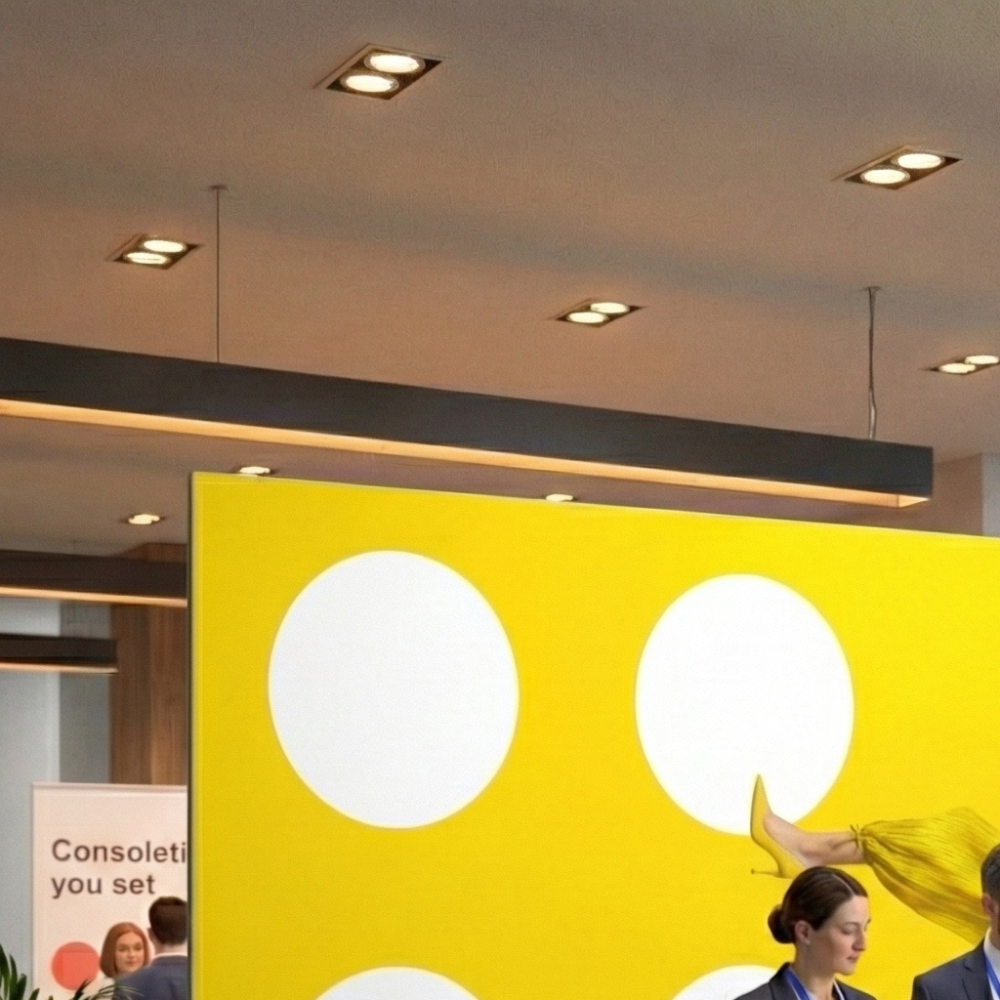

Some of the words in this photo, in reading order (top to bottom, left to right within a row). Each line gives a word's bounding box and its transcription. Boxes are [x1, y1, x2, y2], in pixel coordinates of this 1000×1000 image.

[51, 838, 187, 864] Consoleti
[51, 876, 103, 900] you
[112, 874, 156, 895] set
